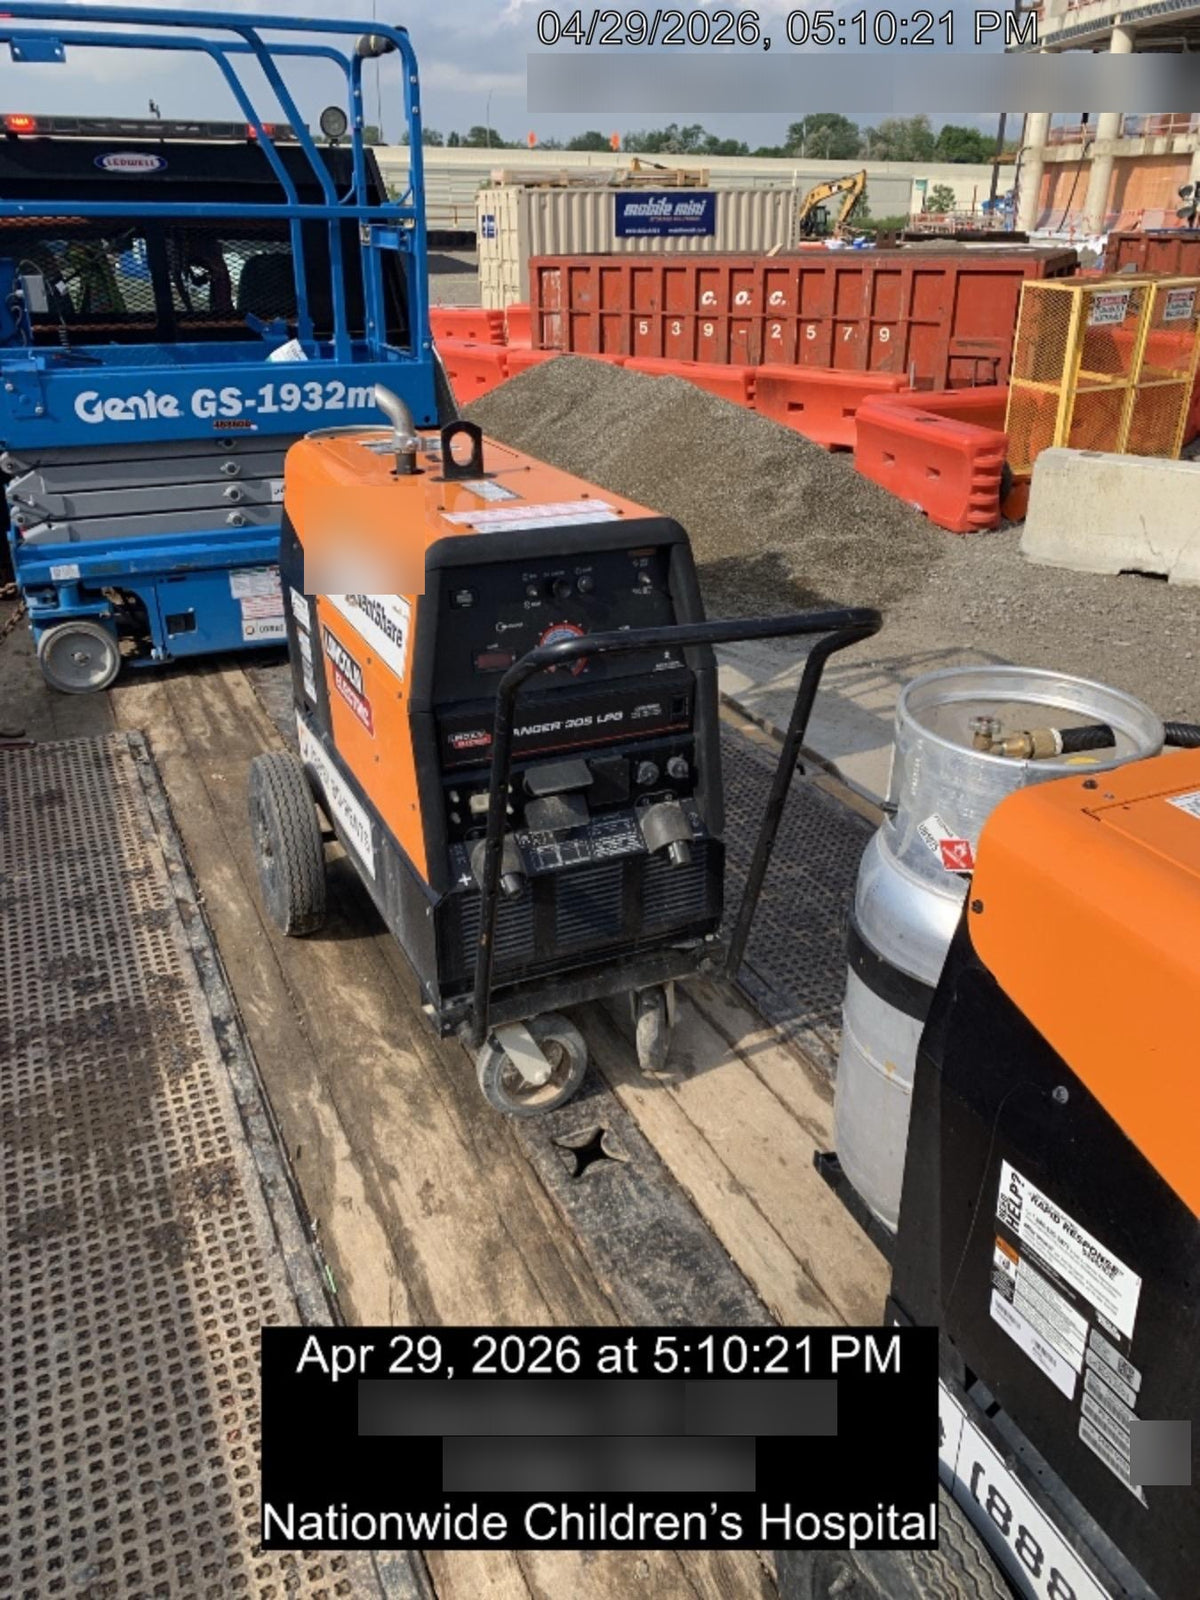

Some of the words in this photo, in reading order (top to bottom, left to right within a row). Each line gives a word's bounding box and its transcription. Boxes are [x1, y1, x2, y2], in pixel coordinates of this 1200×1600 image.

[624, 197, 673, 216] mobile
[673, 199, 707, 216] mini
[74, 389, 181, 423] Genie
[191, 381, 376, 418] GS-1932m
[513, 721, 562, 737] ANGER
[1005, 1172, 1025, 1233] HELP?
